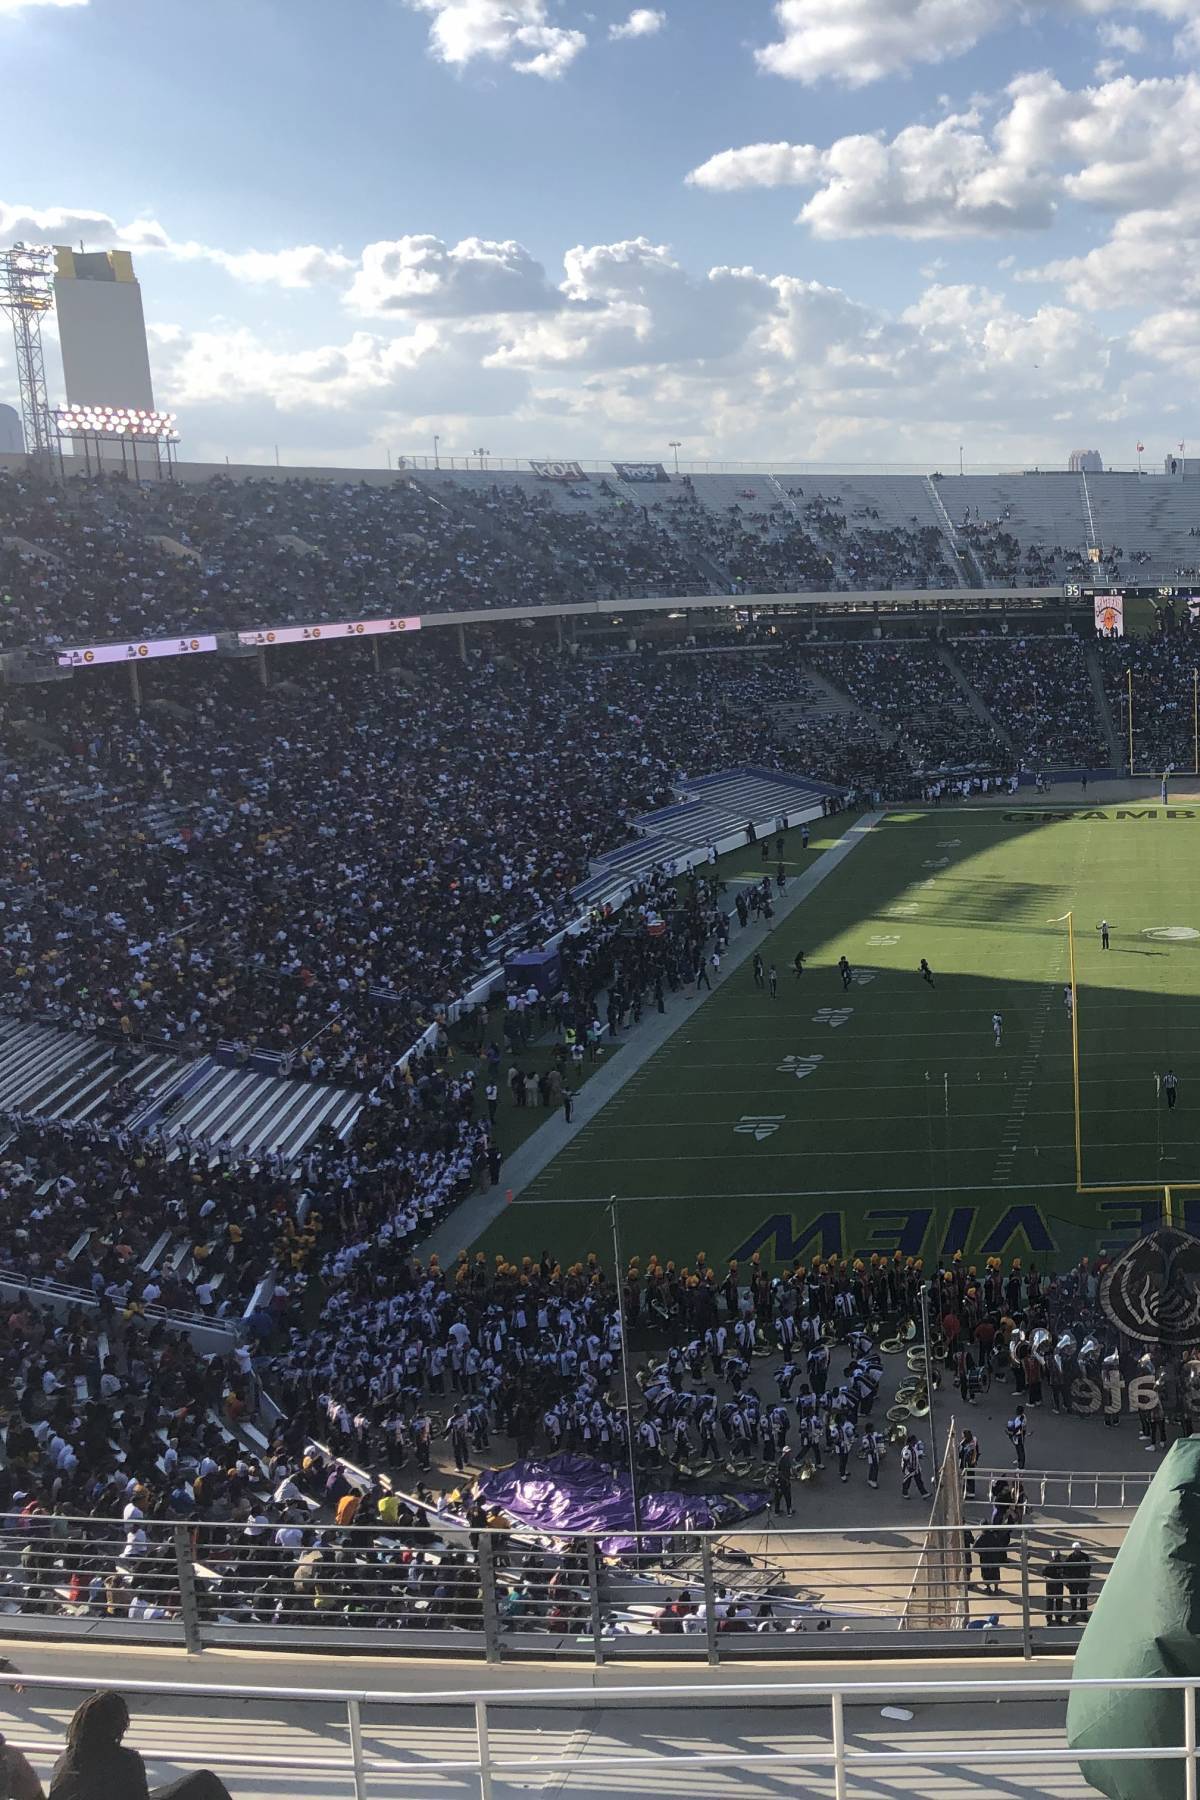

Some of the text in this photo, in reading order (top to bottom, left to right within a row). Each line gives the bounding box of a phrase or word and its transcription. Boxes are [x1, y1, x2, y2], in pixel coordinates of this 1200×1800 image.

[1067, 585, 1079, 596] 35
[811, 1007, 855, 1022] 30
[776, 1054, 825, 1072] 20
[733, 1115, 786, 1133] 10
[728, 1203, 1057, 1262] VIEW
